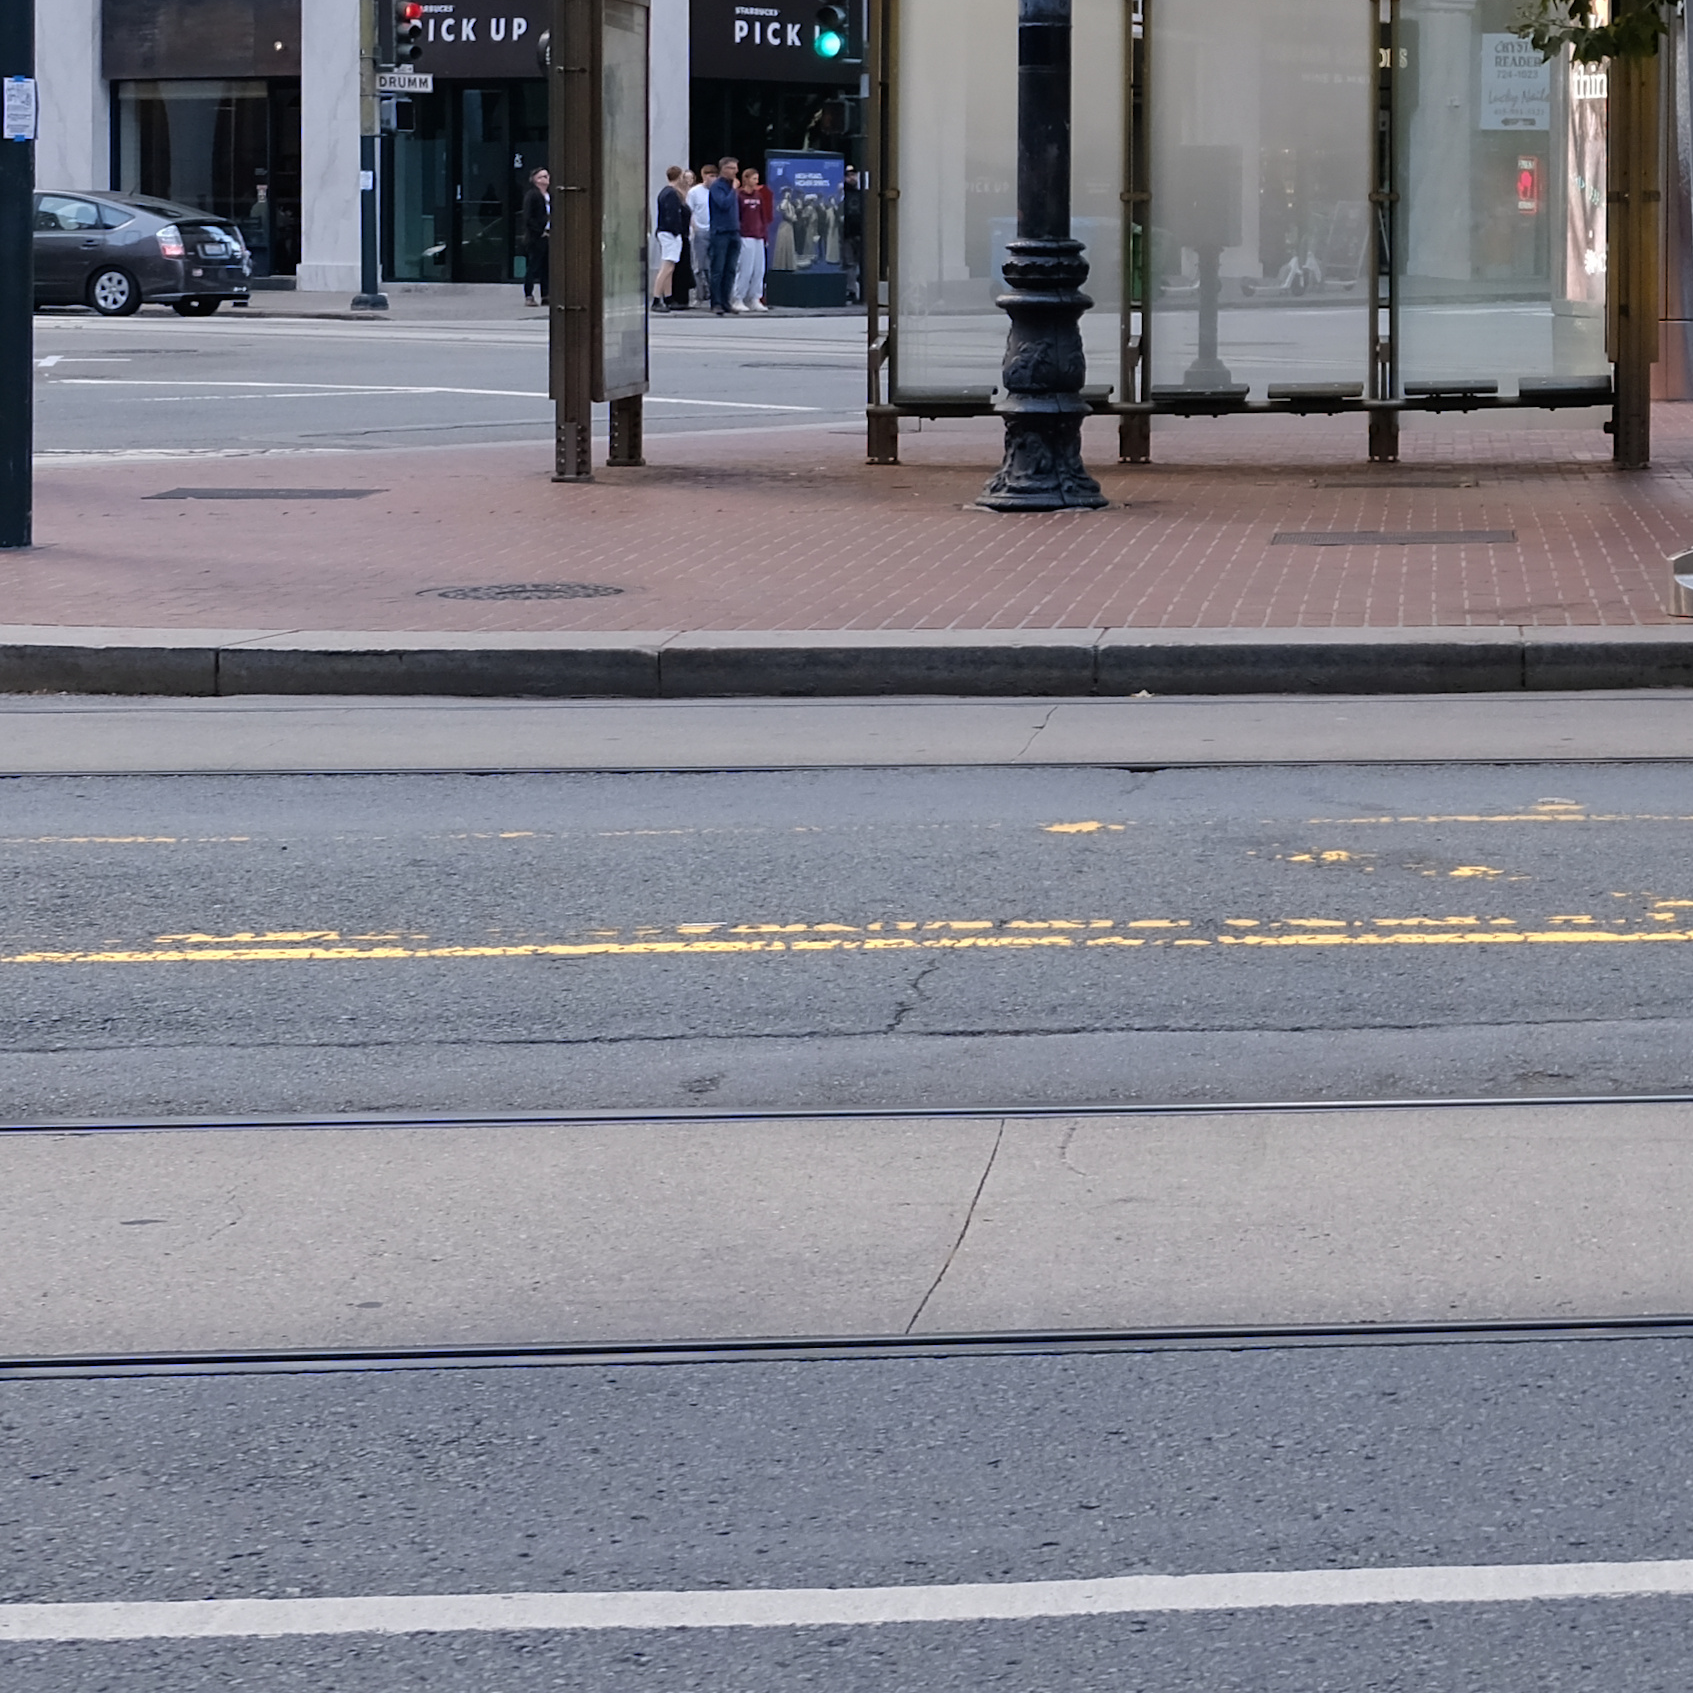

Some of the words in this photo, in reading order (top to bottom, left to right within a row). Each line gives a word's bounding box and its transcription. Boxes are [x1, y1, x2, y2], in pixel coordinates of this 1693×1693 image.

[490, 17, 527, 41] UP
[735, 20, 801, 46] PICK
[379, 76, 429, 88] DRUMM
